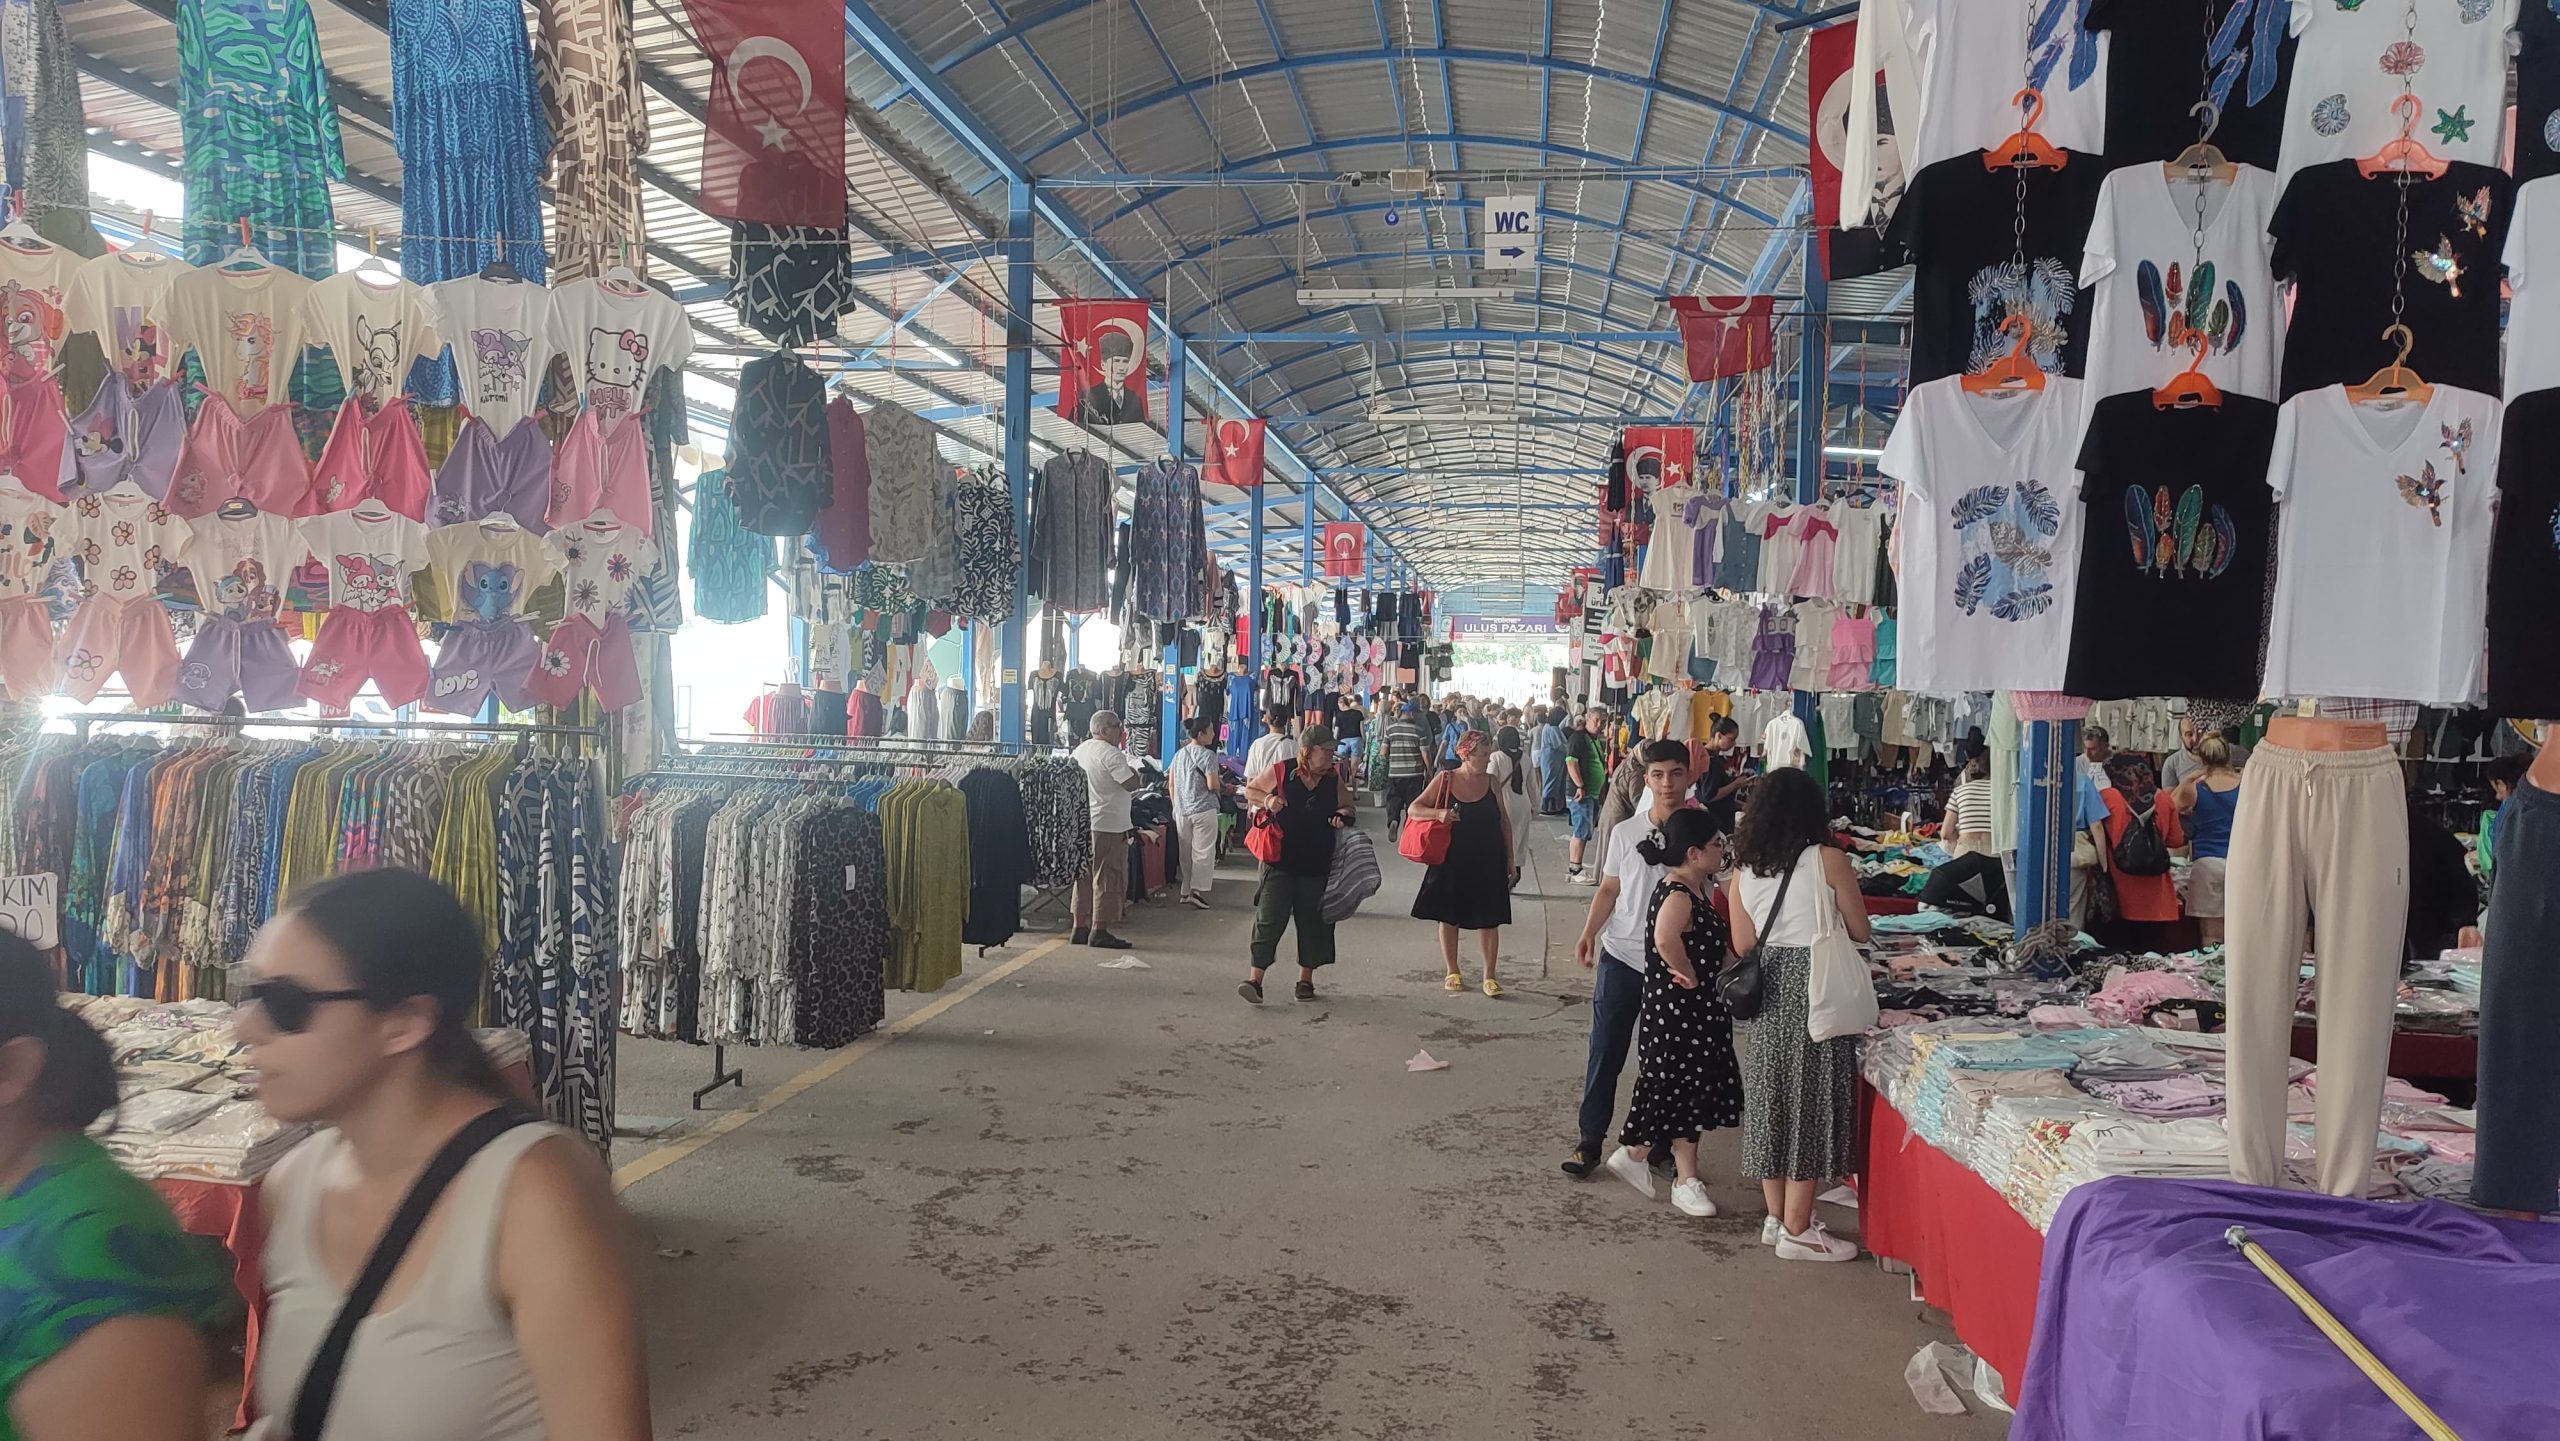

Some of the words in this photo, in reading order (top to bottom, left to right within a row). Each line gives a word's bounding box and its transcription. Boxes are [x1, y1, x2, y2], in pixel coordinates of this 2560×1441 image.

[1495, 211, 1529, 233] WC
[1464, 623, 1498, 633] ULUS
[1501, 623, 1547, 633] PAZARI
